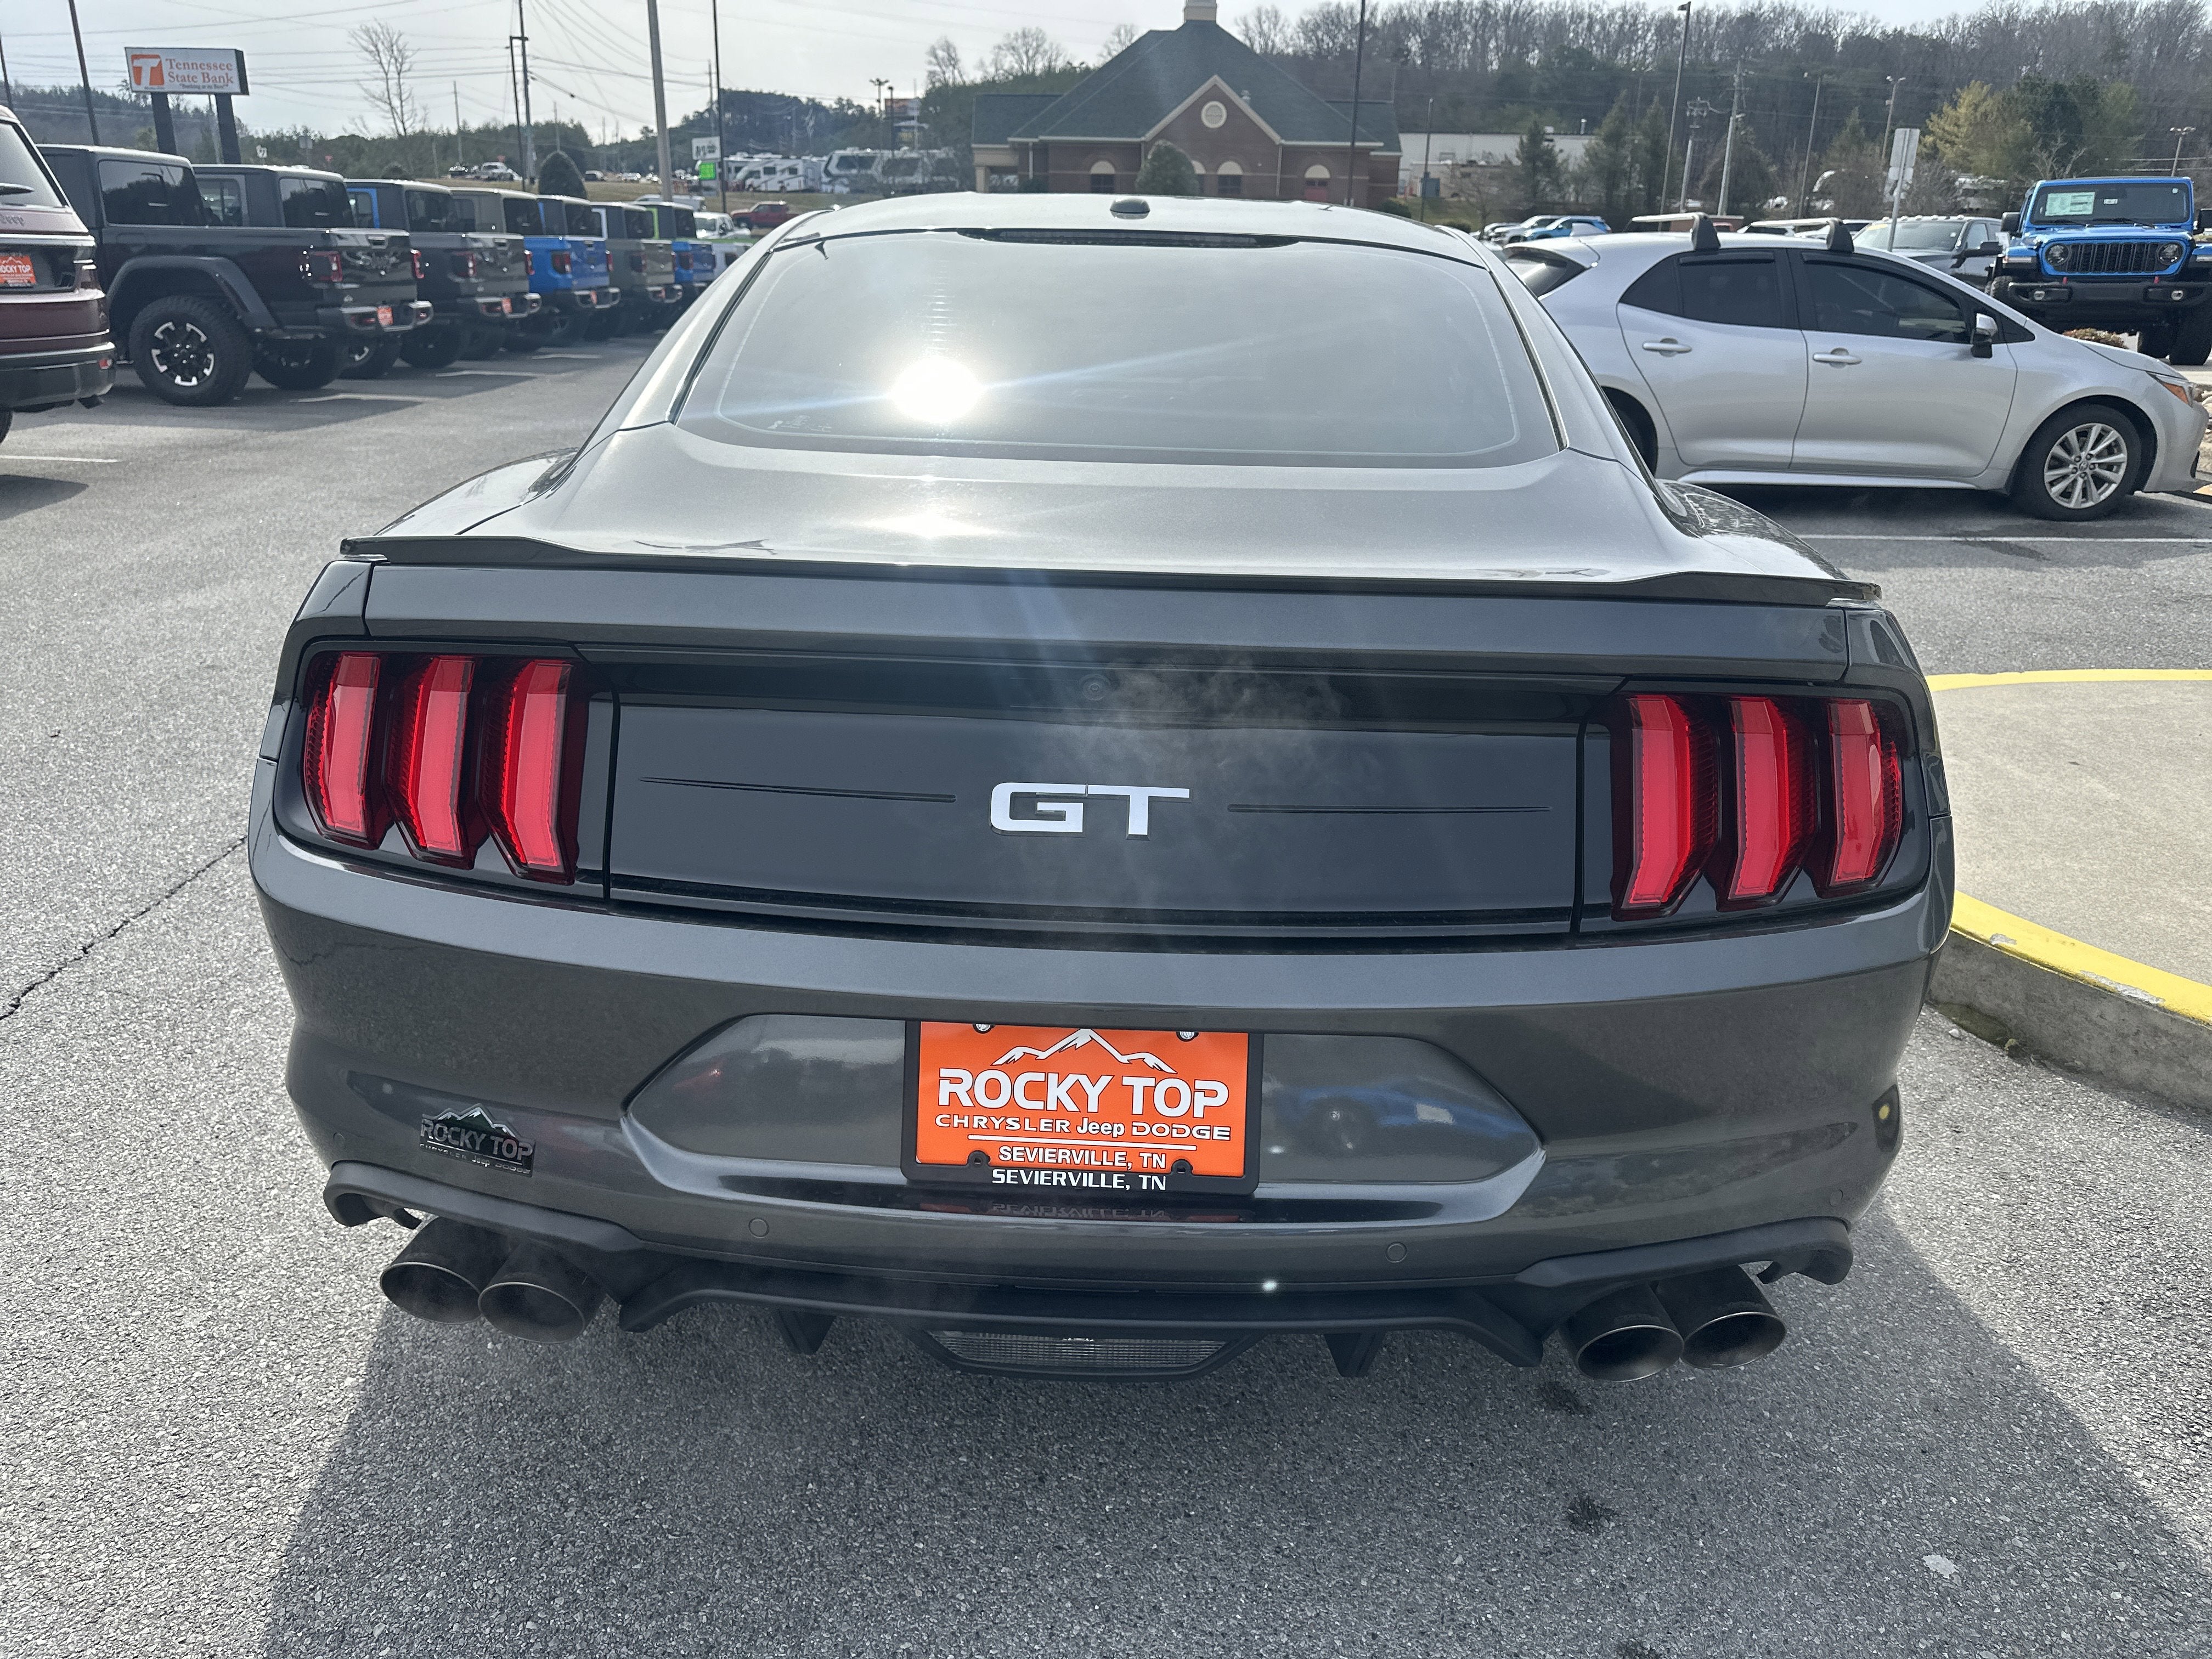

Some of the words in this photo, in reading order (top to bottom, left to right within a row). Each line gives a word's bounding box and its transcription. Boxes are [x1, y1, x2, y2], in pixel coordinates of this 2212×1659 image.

[166, 58, 233, 70] Tennessee
[168, 71, 198, 83] State
[201, 72, 233, 84] Bank
[989, 782, 1190, 839] GT
[939, 1068, 1114, 1113] ROCKY
[1122, 1076, 1230, 1119] TOP
[421, 1119, 486, 1150] ROCKY
[490, 1135, 533, 1160] TOP
[935, 1114, 1071, 1133] CHRYSLER
[1076, 1117, 1125, 1138] Jeep
[1132, 1121, 1231, 1141] DODGE
[495, 1163, 531, 1173] DODGE
[998, 1146, 1132, 1170] SEVIERVILLE,
[1139, 1153, 1166, 1169] TN
[992, 1169, 1130, 1190] SEVIERVILLE,
[1138, 1175, 1166, 1190] TN
